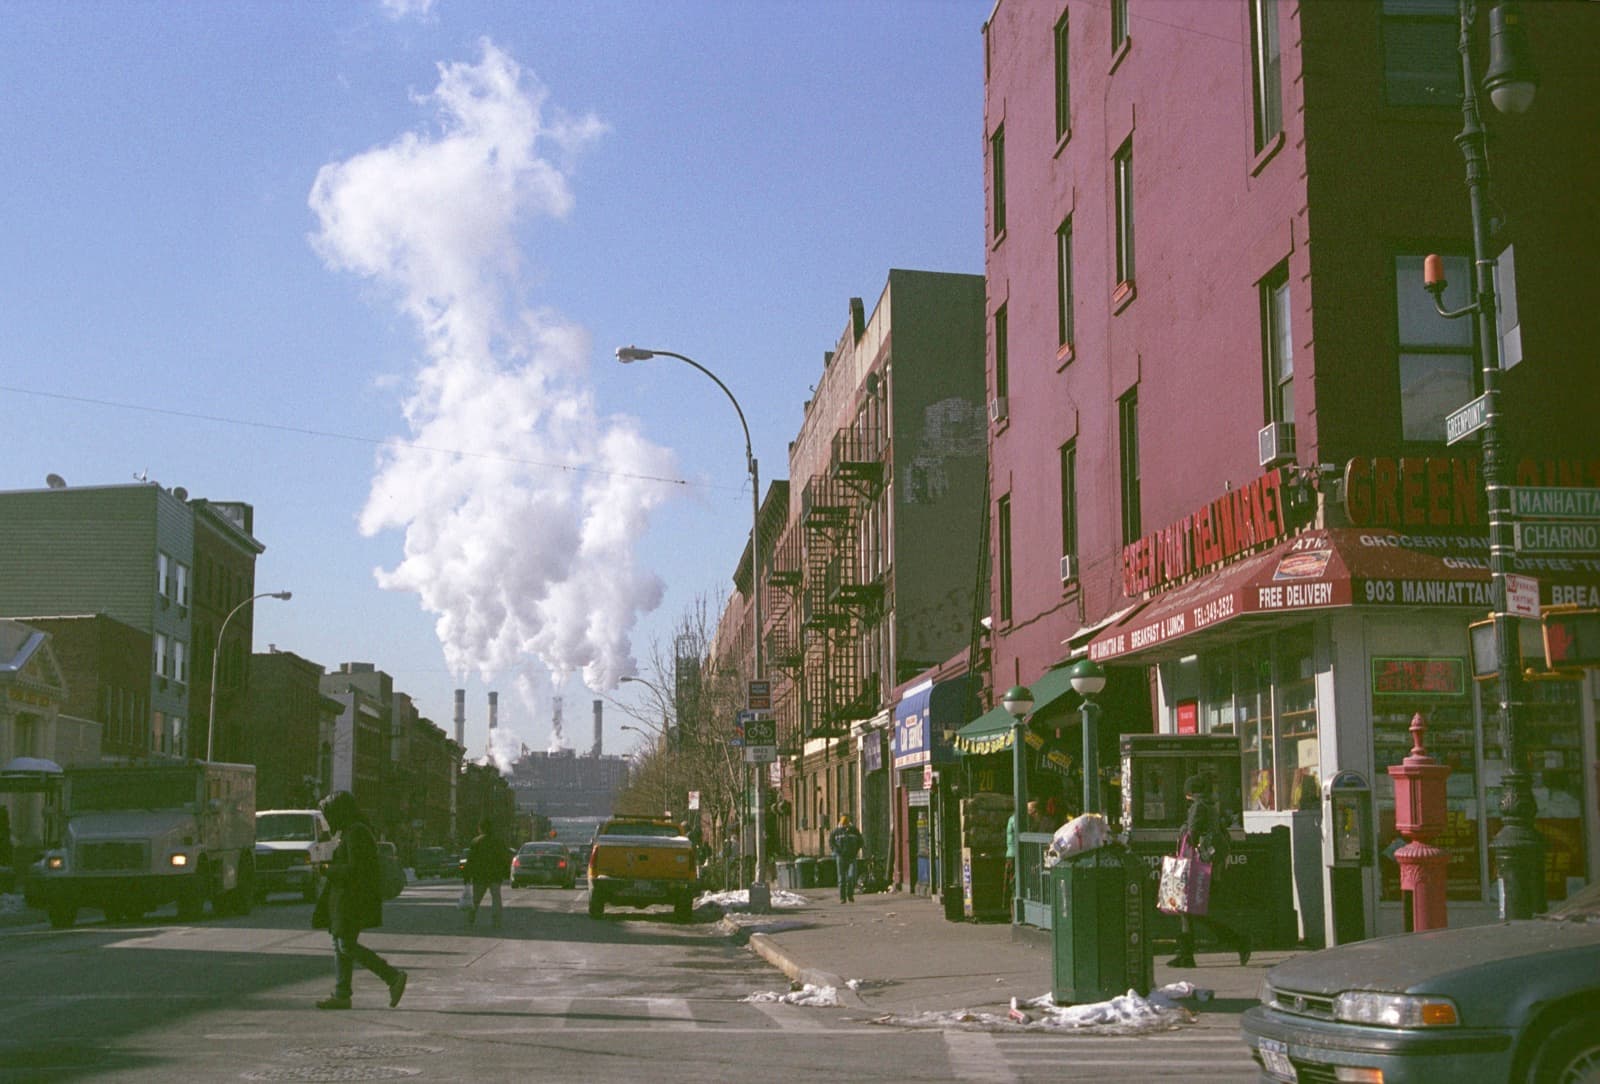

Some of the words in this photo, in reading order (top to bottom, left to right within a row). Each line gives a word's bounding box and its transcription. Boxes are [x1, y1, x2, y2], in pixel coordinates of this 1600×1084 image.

[1447, 402, 1481, 441] GREENPOINT
[1221, 468, 1285, 558] MARKET
[1513, 557, 1574, 572] OFFEE
[1259, 585, 1283, 608] FREE
[1286, 582, 1333, 606] DELIVERY
[1365, 580, 1395, 602] 903
[1131, 622, 1160, 650] BREAKFAST
[1161, 620, 1166, 640] &
[1166, 613, 1185, 638] LUNCH
